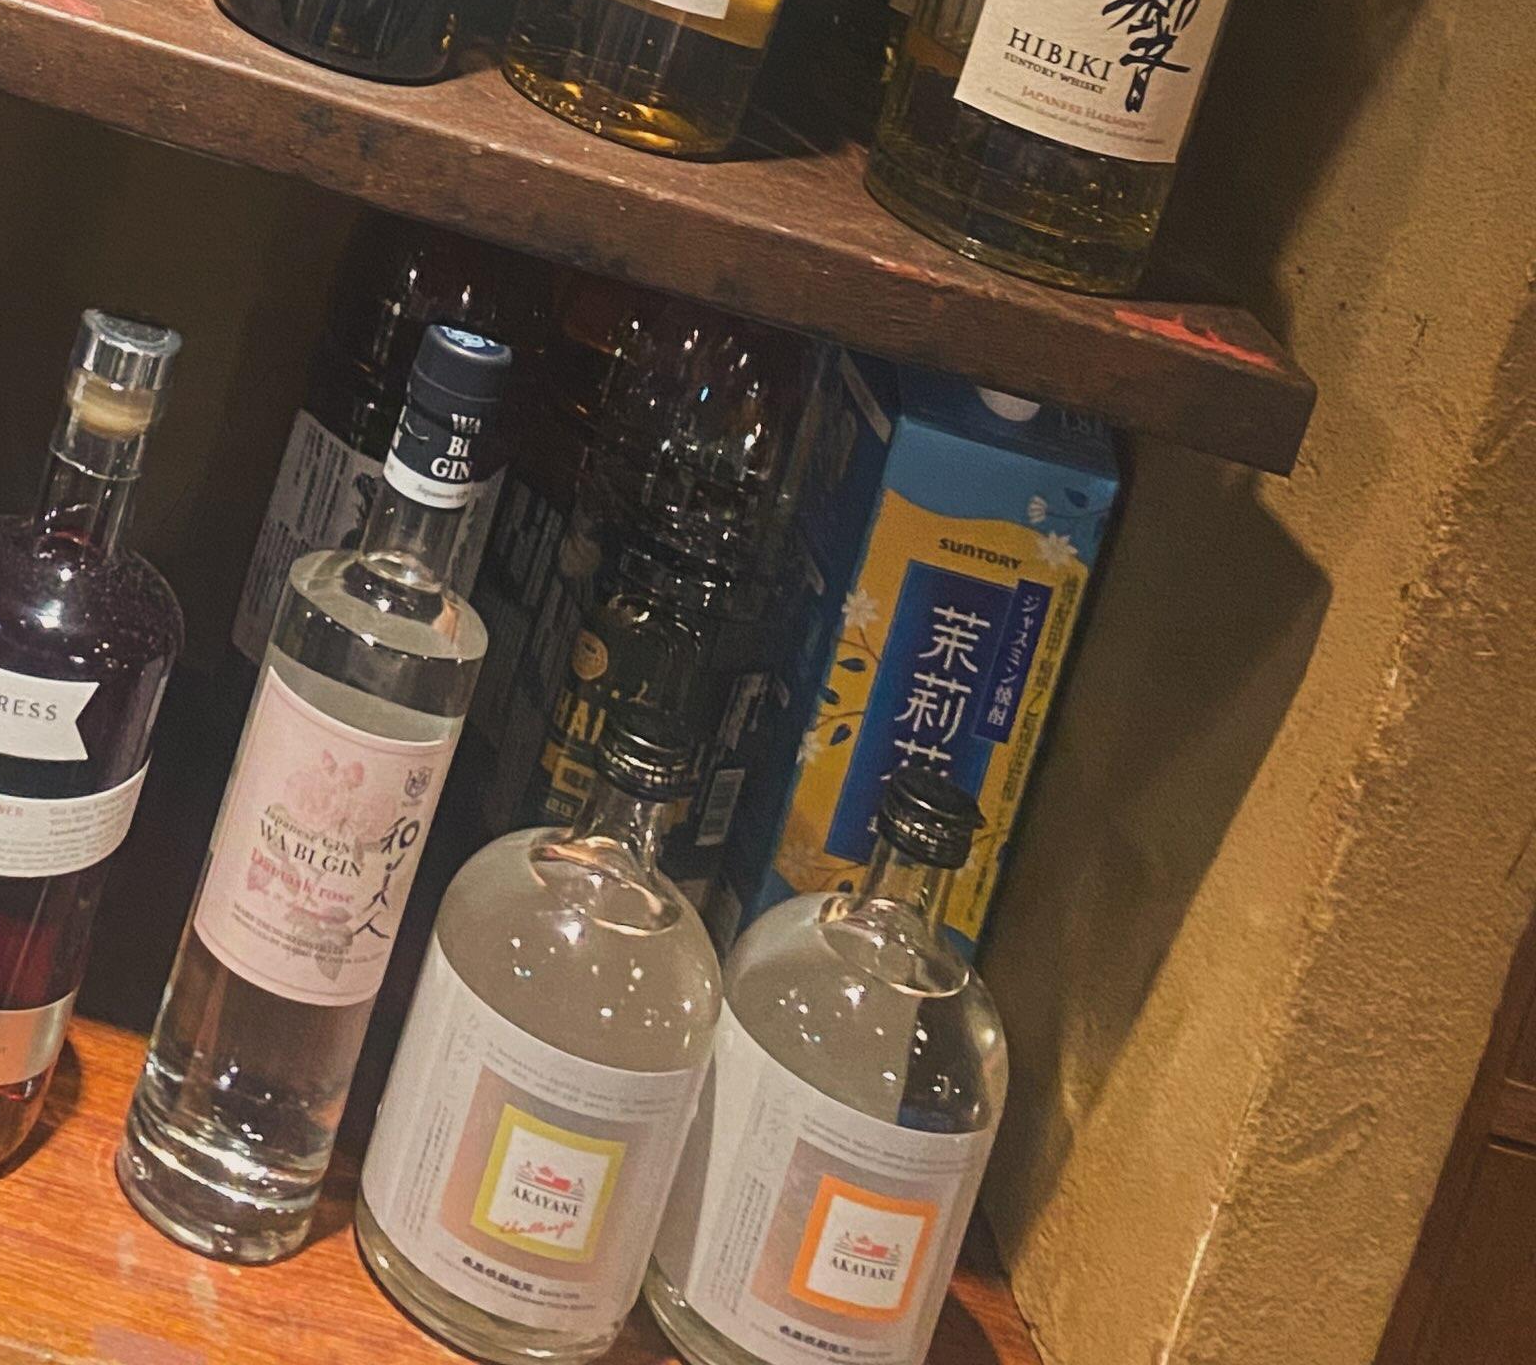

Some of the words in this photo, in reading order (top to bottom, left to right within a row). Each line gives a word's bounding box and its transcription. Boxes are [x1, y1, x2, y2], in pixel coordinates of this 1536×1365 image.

[1006, 26, 1115, 83] HIBIKI
[1002, 51, 1058, 80] SUNTORY
[1059, 71, 1107, 96] WHISKY
[1020, 84, 1084, 117] JAPANESE
[1084, 106, 1149, 132] HARMONY
[445, 434, 471, 459] BI
[429, 457, 474, 483] GIN
[937, 536, 1023, 571] SUNTORY
[987, 593, 1042, 728] ジャスミン焼酎
[257, 818, 290, 858] WA
[292, 838, 317, 863] BI
[320, 847, 366, 878] GIN
[320, 833, 353, 854] GIN
[510, 1186, 583, 1219] AKAYANE
[830, 1253, 899, 1283] AKAYANE
